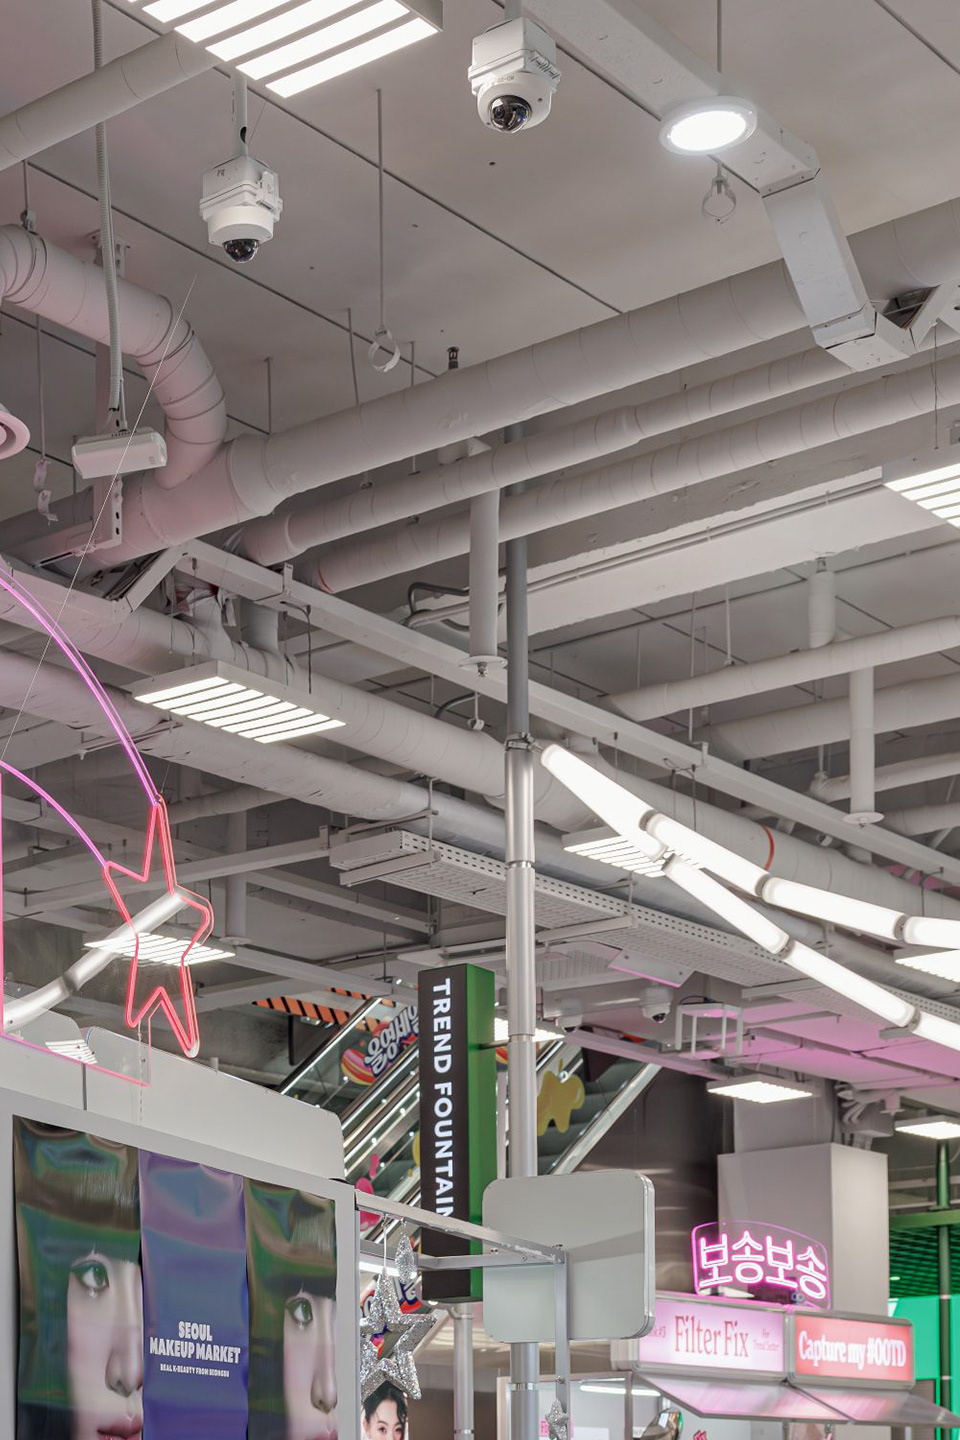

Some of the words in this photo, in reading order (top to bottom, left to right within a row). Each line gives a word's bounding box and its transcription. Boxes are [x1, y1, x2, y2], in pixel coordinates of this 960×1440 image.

[433, 978, 452, 1073] TREND
[699, 1231, 827, 1299] 보송보송
[149, 1337, 195, 1358] MAKEUP
[196, 1343, 241, 1364] MARKET
[178, 1321, 213, 1341] SEOUL
[675, 1315, 721, 1355] Filter
[724, 1320, 749, 1358] Fix
[798, 1330, 846, 1367] Capture
[847, 1343, 866, 1371] my
[867, 1337, 906, 1367] #OOTD
